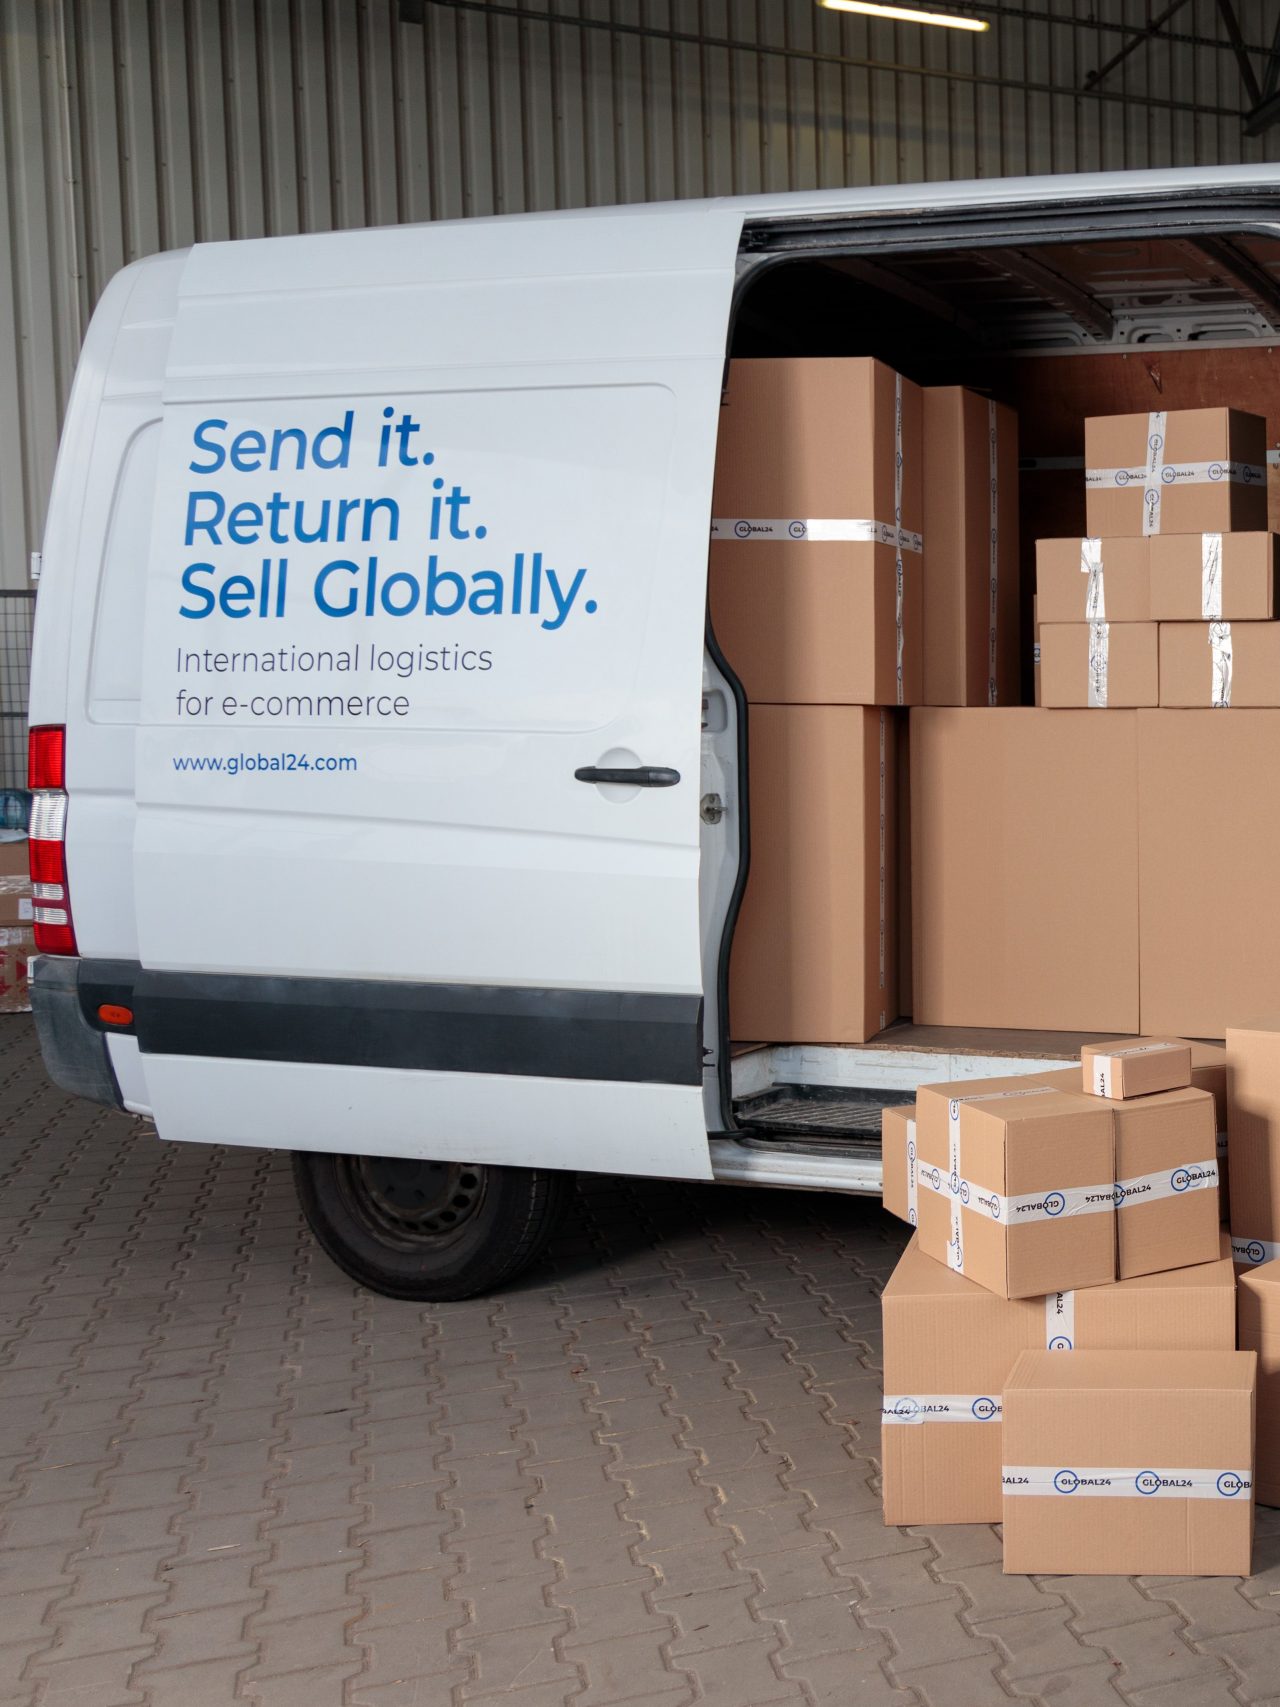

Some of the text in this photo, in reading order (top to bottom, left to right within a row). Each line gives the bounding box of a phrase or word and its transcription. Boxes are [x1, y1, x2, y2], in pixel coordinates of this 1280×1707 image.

[188, 406, 436, 475] Send it.
[184, 476, 488, 547] Return it.
[179, 551, 599, 631] Sell Globally.
[176, 643, 493, 678] International logistics
[176, 689, 410, 716] for e-commerce
[174, 751, 357, 775] www.global24.com
[1176, 1170, 1215, 1184] GLOBAL24
[1016, 1200, 1059, 1212] GLOBAL24
[1061, 1478, 1111, 1487] GLOBAL24
[1142, 1479, 1192, 1488] GLOBAL24
